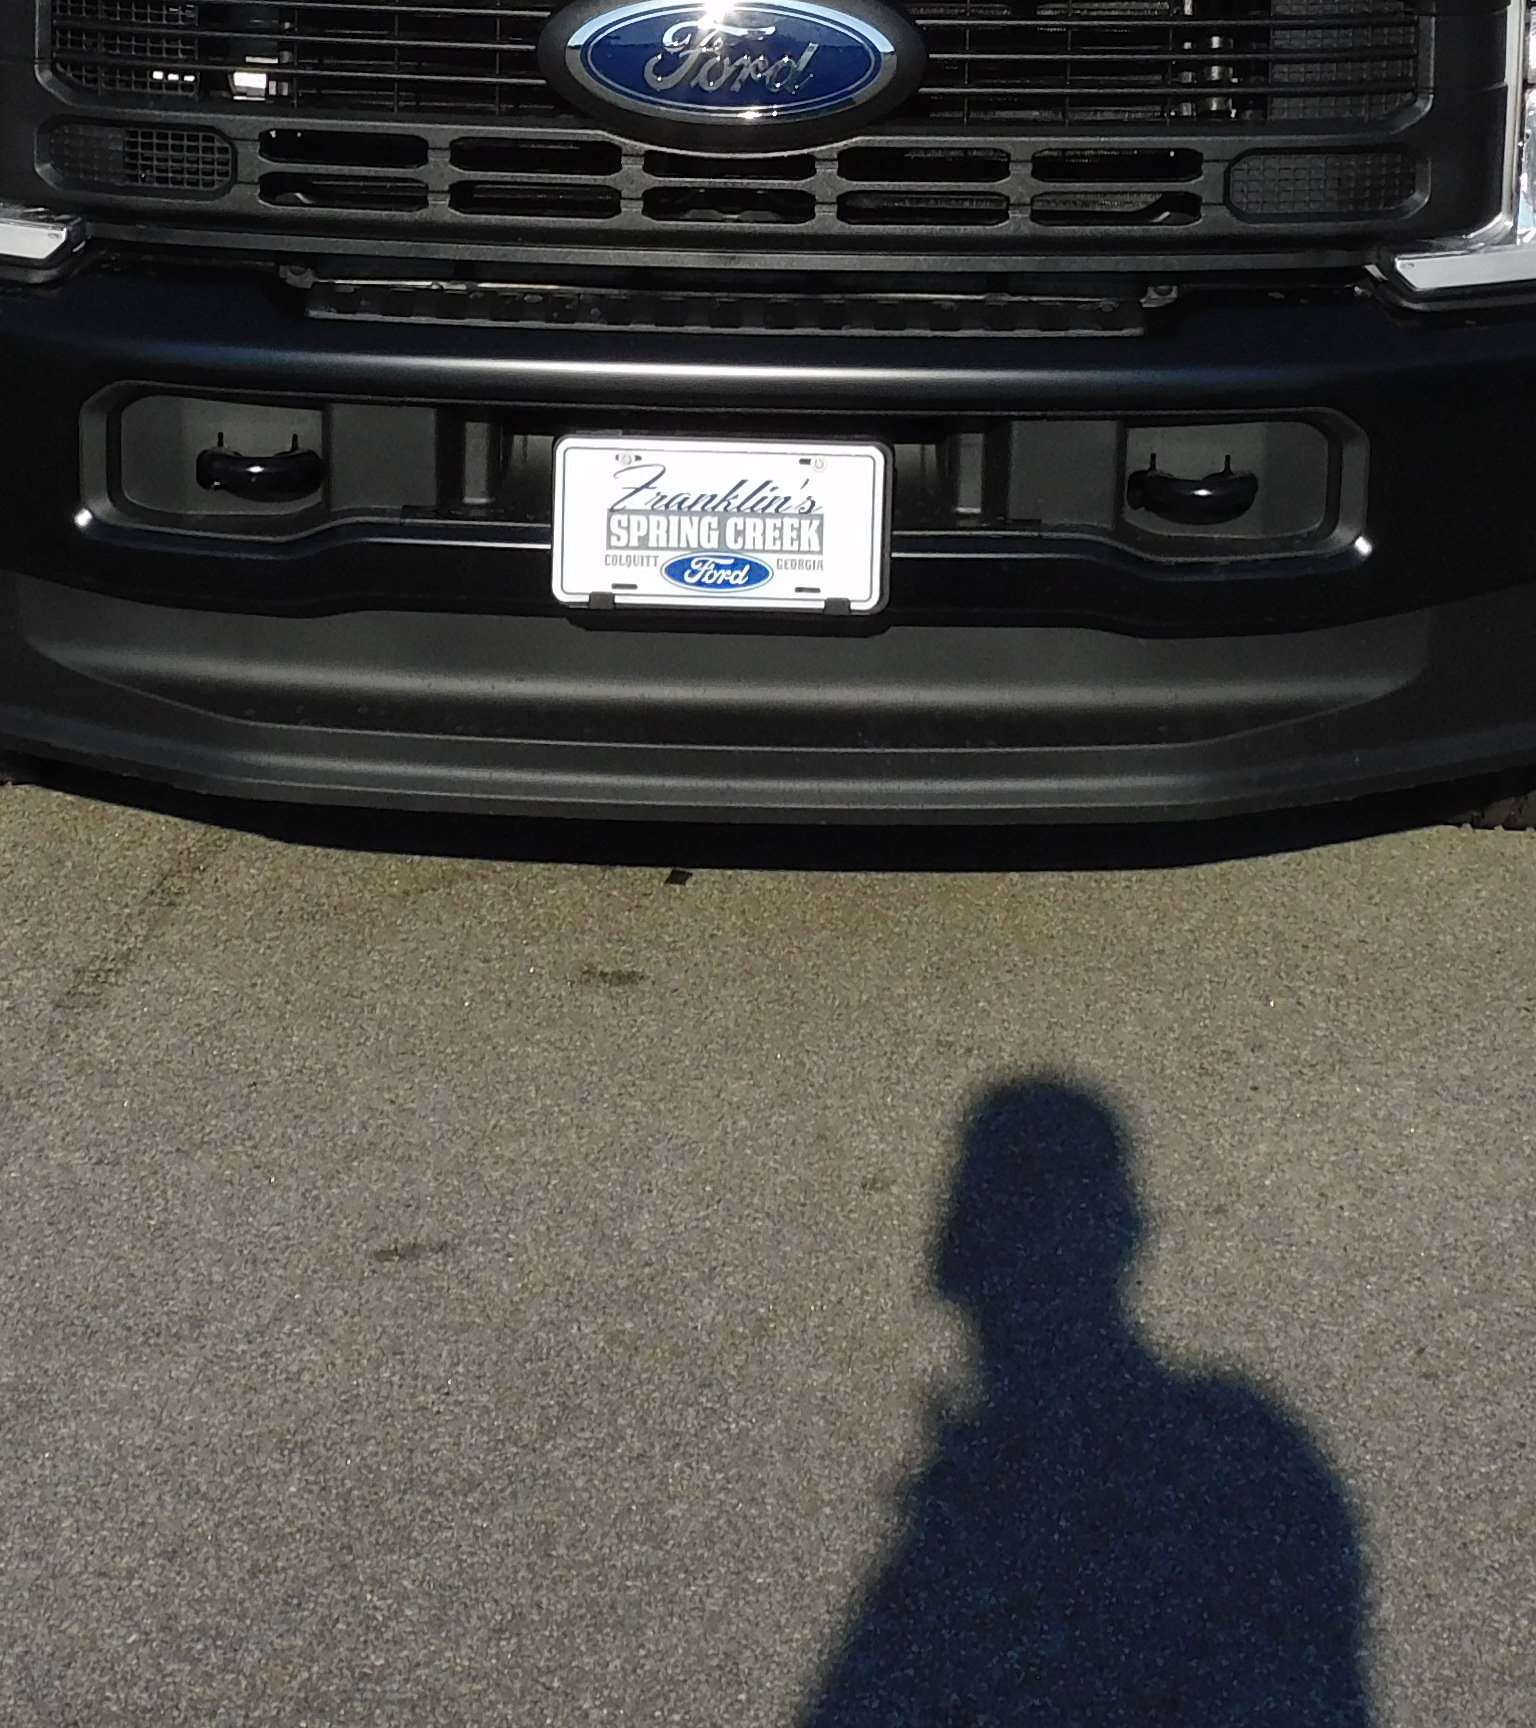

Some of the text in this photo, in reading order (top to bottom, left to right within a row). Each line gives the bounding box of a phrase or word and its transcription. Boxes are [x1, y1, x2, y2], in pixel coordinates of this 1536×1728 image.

[642, 19, 820, 94] Ford
[609, 463, 823, 515] Franklin's
[609, 514, 821, 552] SPRING CREEK
[604, 554, 660, 569] COLQUITT
[683, 556, 752, 585] Ford
[776, 558, 824, 572] GEORGIA
